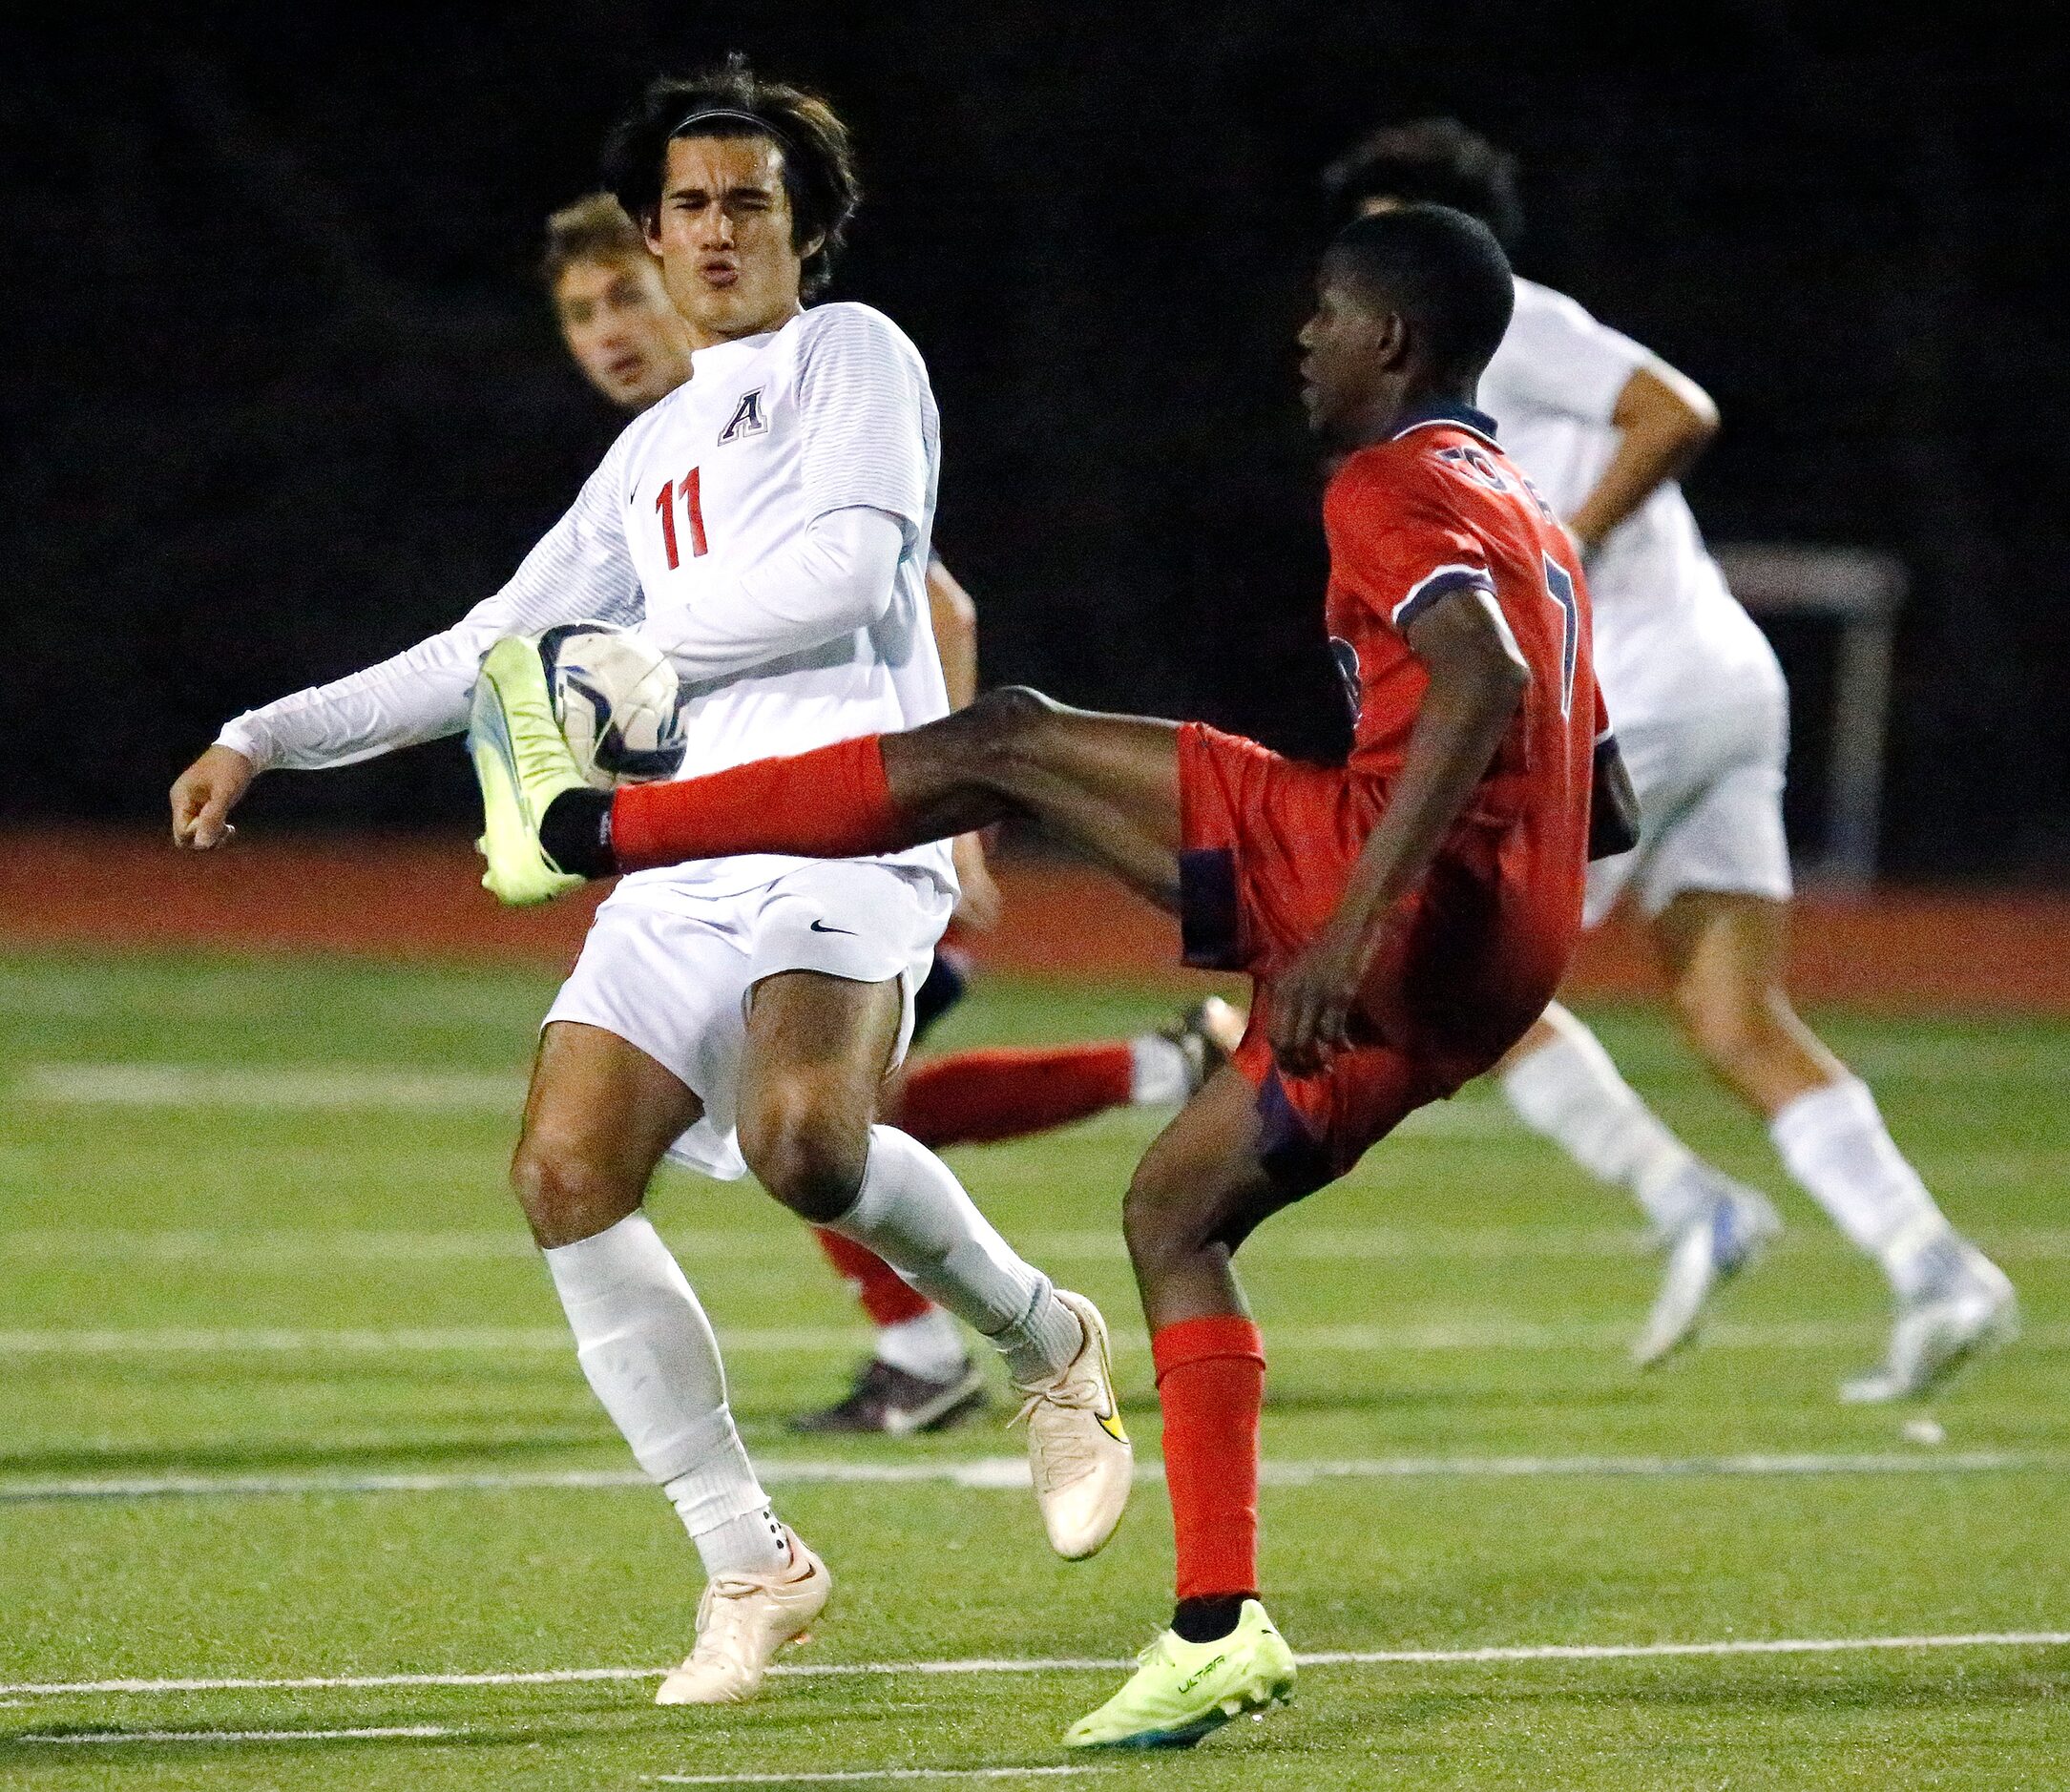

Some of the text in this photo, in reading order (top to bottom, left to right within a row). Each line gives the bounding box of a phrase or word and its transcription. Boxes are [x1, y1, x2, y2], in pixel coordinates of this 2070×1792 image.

[718, 385, 768, 447] A
[656, 466, 708, 571] 11
[1540, 549, 1579, 723] 7
[1178, 1655, 1225, 1695] ULTRA
